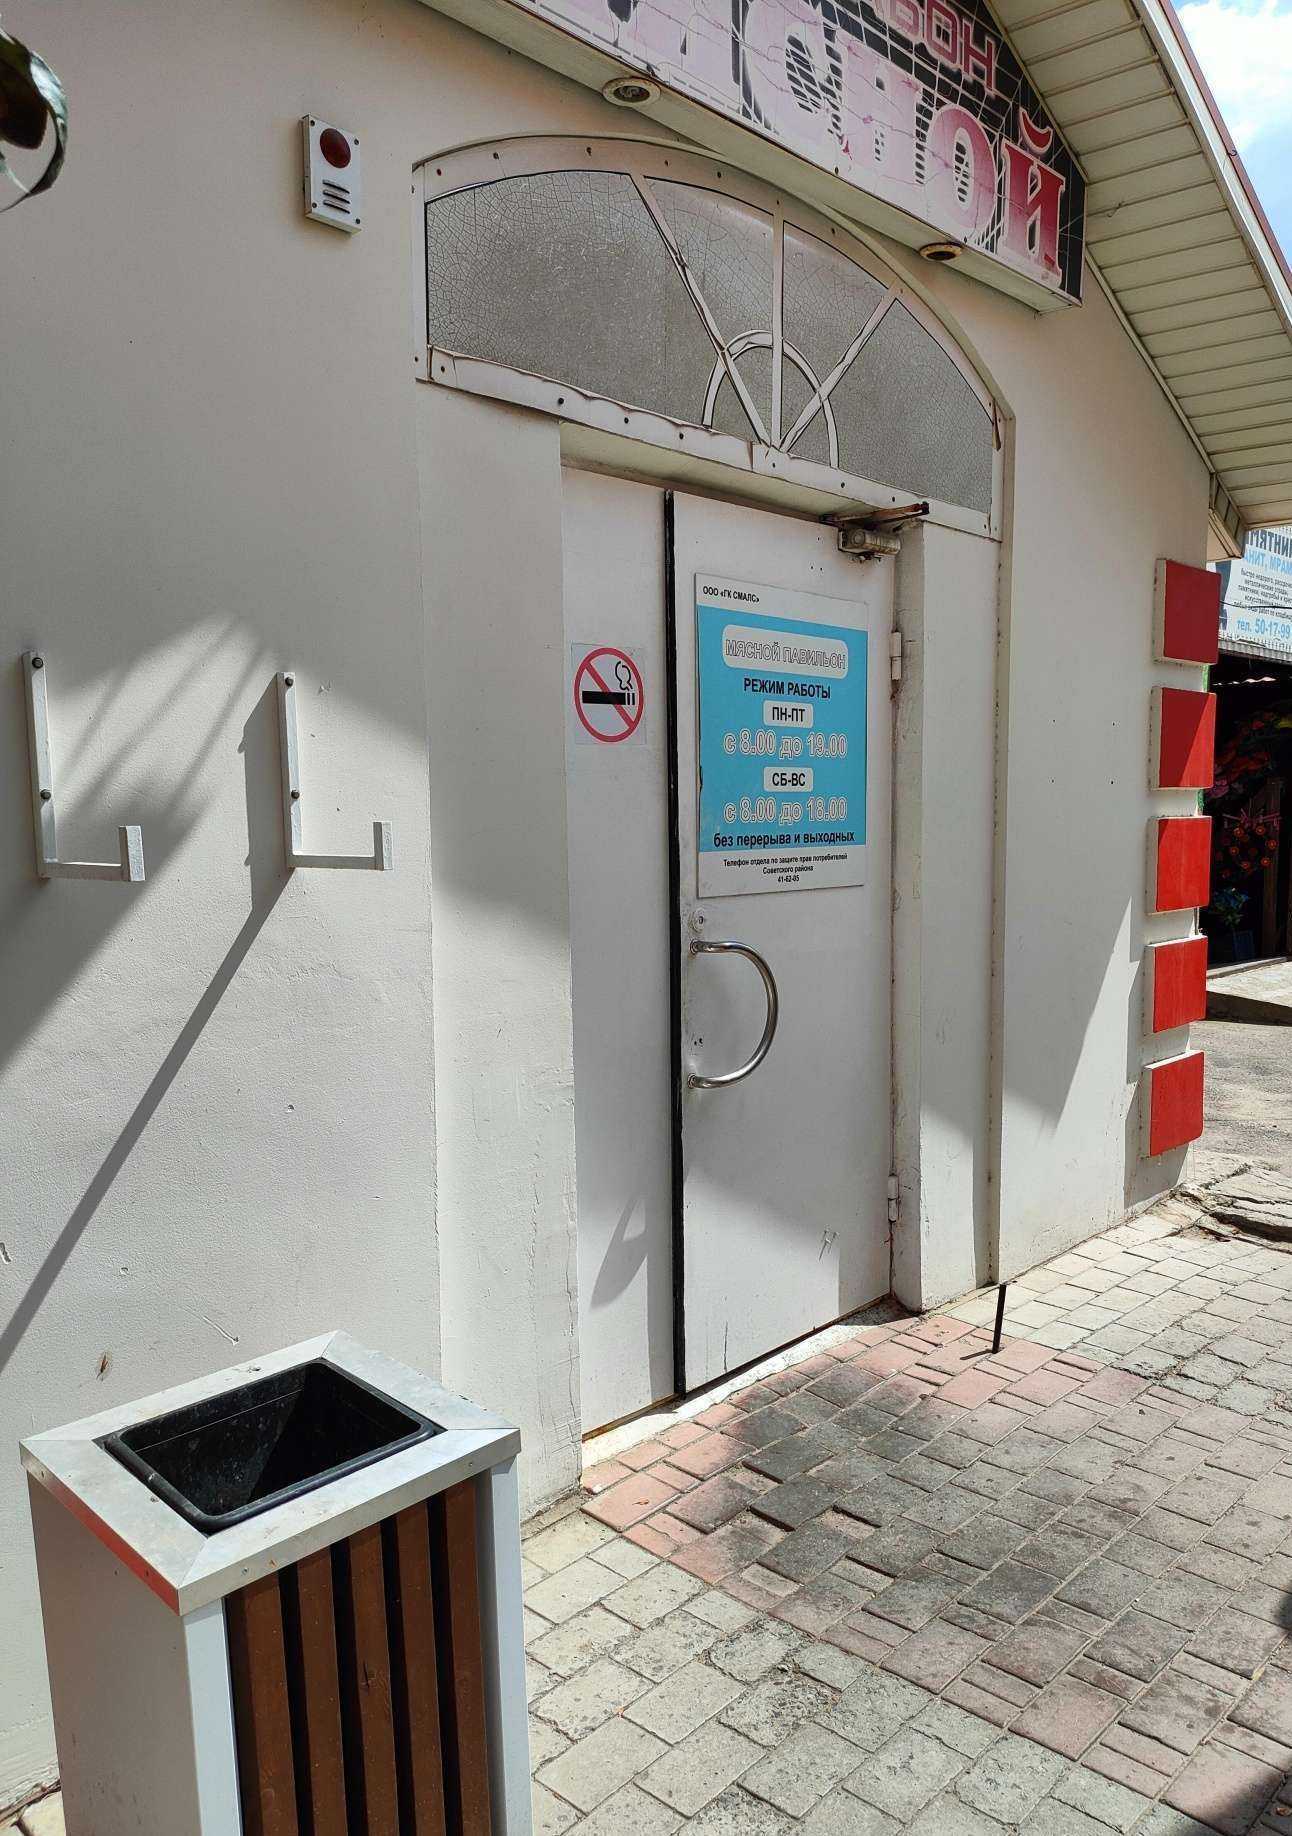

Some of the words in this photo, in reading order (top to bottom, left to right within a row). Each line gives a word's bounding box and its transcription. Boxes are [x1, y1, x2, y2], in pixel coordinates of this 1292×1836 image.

[703, 586, 719, 596] ООО
[725, 639, 780, 662] МЯСНОЙ
[783, 646, 847, 669] ПАВИЛЬОН
[743, 678, 785, 695] РЕЖИМ
[787, 682, 831, 699] РАБОТЫ
[772, 706, 806, 723] ПН-ПТ
[739, 728, 777, 756] 8.00
[779, 735, 804, 760] до
[807, 731, 848, 759] 19.00
[772, 772, 806, 787] СБ-ВС
[739, 796, 777, 823] 8.00
[779, 801, 804, 827] до
[807, 796, 848, 822] 18.00
[713, 833, 734, 848] без
[736, 833, 791, 849] перерыва
[794, 834, 801, 844] и
[803, 831, 856, 845] выходных
[723, 858, 749, 868] Телефон
[762, 865, 794, 875] Советского
[795, 864, 814, 874] района
